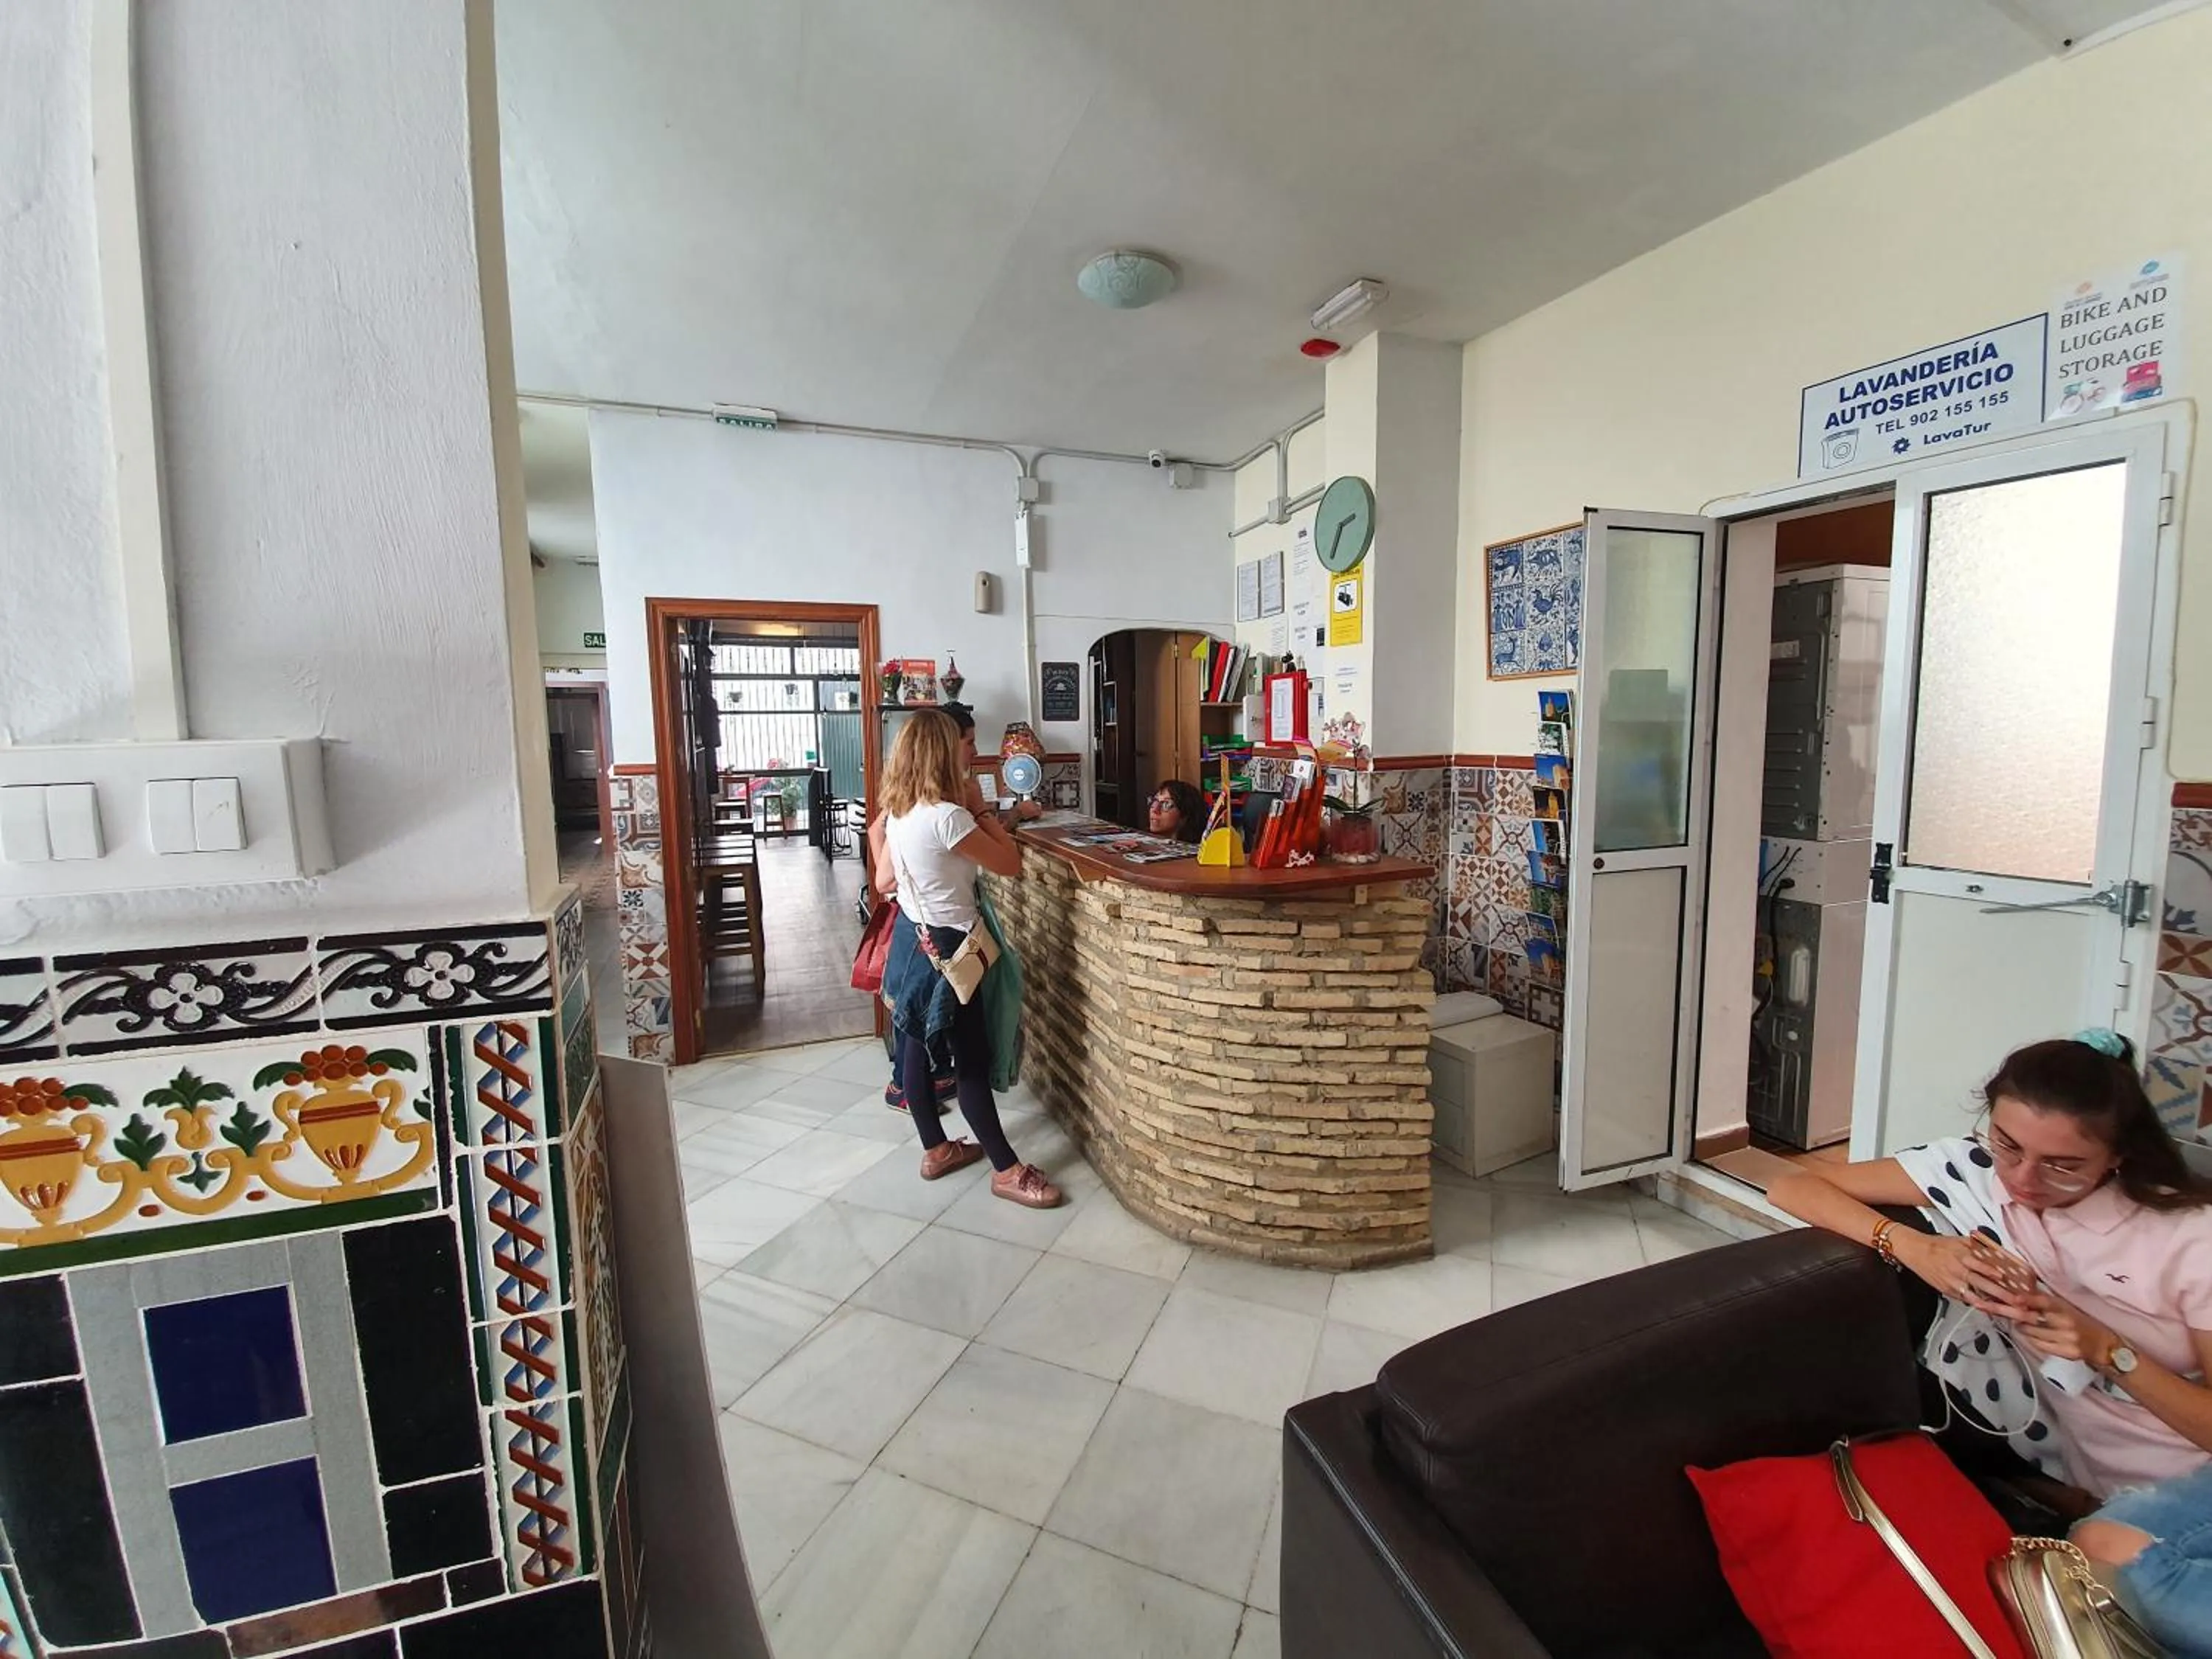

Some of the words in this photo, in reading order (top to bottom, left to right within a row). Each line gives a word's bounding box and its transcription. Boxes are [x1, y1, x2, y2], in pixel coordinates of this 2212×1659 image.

[2061, 302, 2111, 329] BIKE
[2117, 287, 2167, 313] AND
[2060, 313, 2166, 353] LUGGAGE
[1839, 341, 1999, 403] LAVANDERÍA
[2059, 340, 2164, 379] STORAGE
[1824, 364, 2014, 430] AUTOSERVICIO
[1875, 418, 1905, 434] TEL
[1910, 409, 1938, 426] 902
[1944, 400, 1972, 417] 155
[1979, 391, 2009, 408] 155
[1924, 422, 1992, 445] LavaTur
[585, 635, 605, 646] SAL
